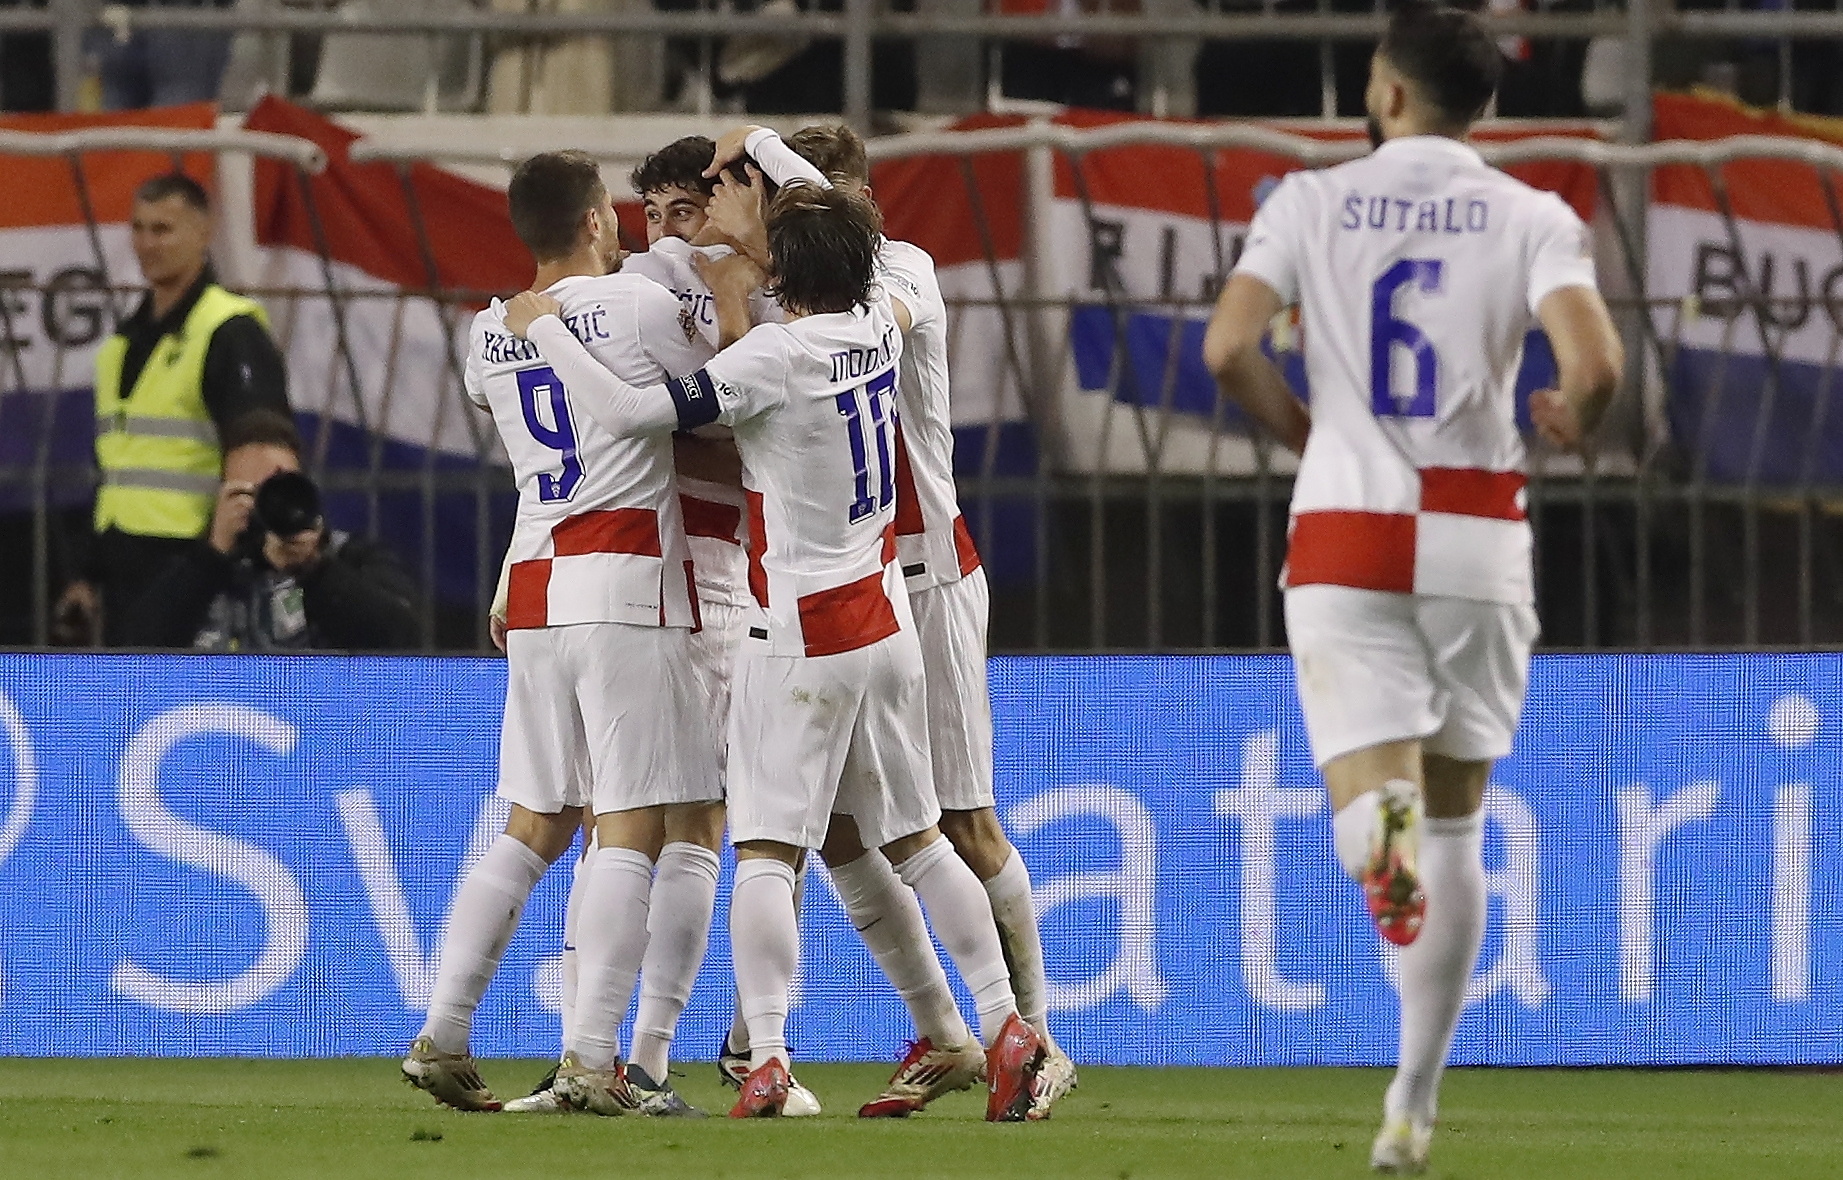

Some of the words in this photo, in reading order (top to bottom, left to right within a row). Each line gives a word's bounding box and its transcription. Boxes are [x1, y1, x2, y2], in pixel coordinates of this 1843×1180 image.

[1341, 189, 1489, 234] ŠUTALO
[1369, 257, 1444, 419] 6
[515, 366, 586, 504] 9
[835, 366, 897, 526] 10
